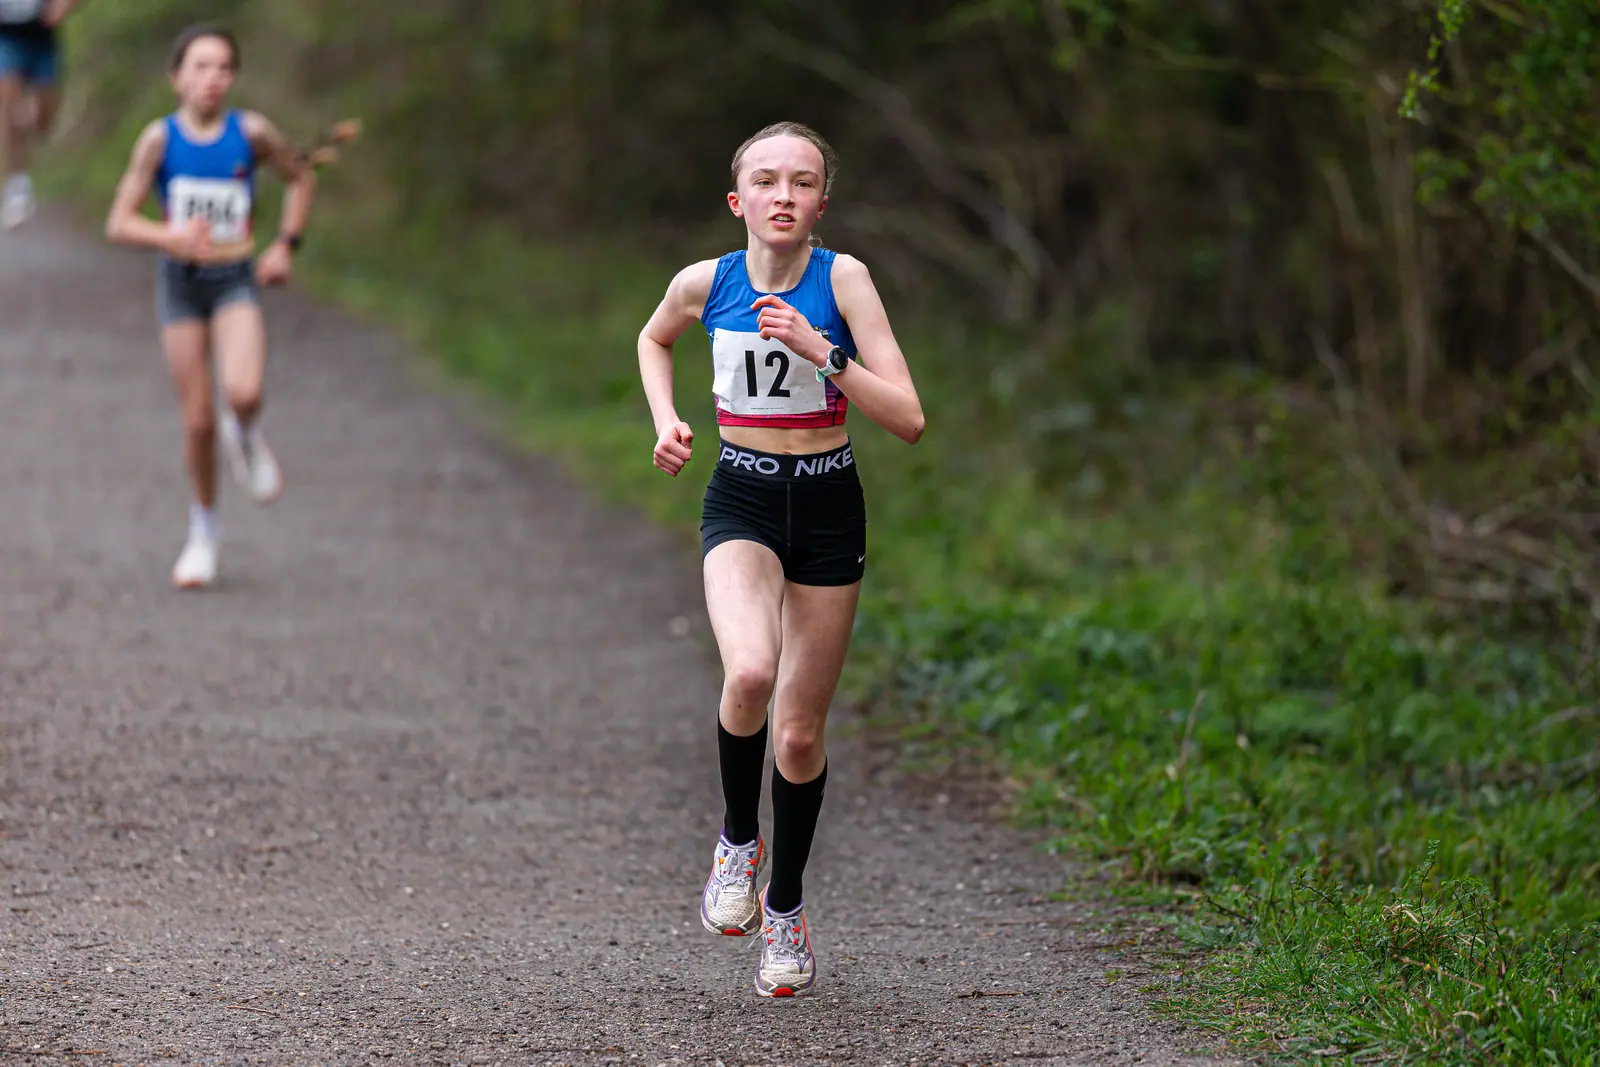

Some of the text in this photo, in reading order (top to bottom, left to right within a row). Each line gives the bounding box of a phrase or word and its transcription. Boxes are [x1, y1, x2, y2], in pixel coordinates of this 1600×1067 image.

[744, 350, 791, 398] 12
[719, 447, 853, 477] PRO NIKE
